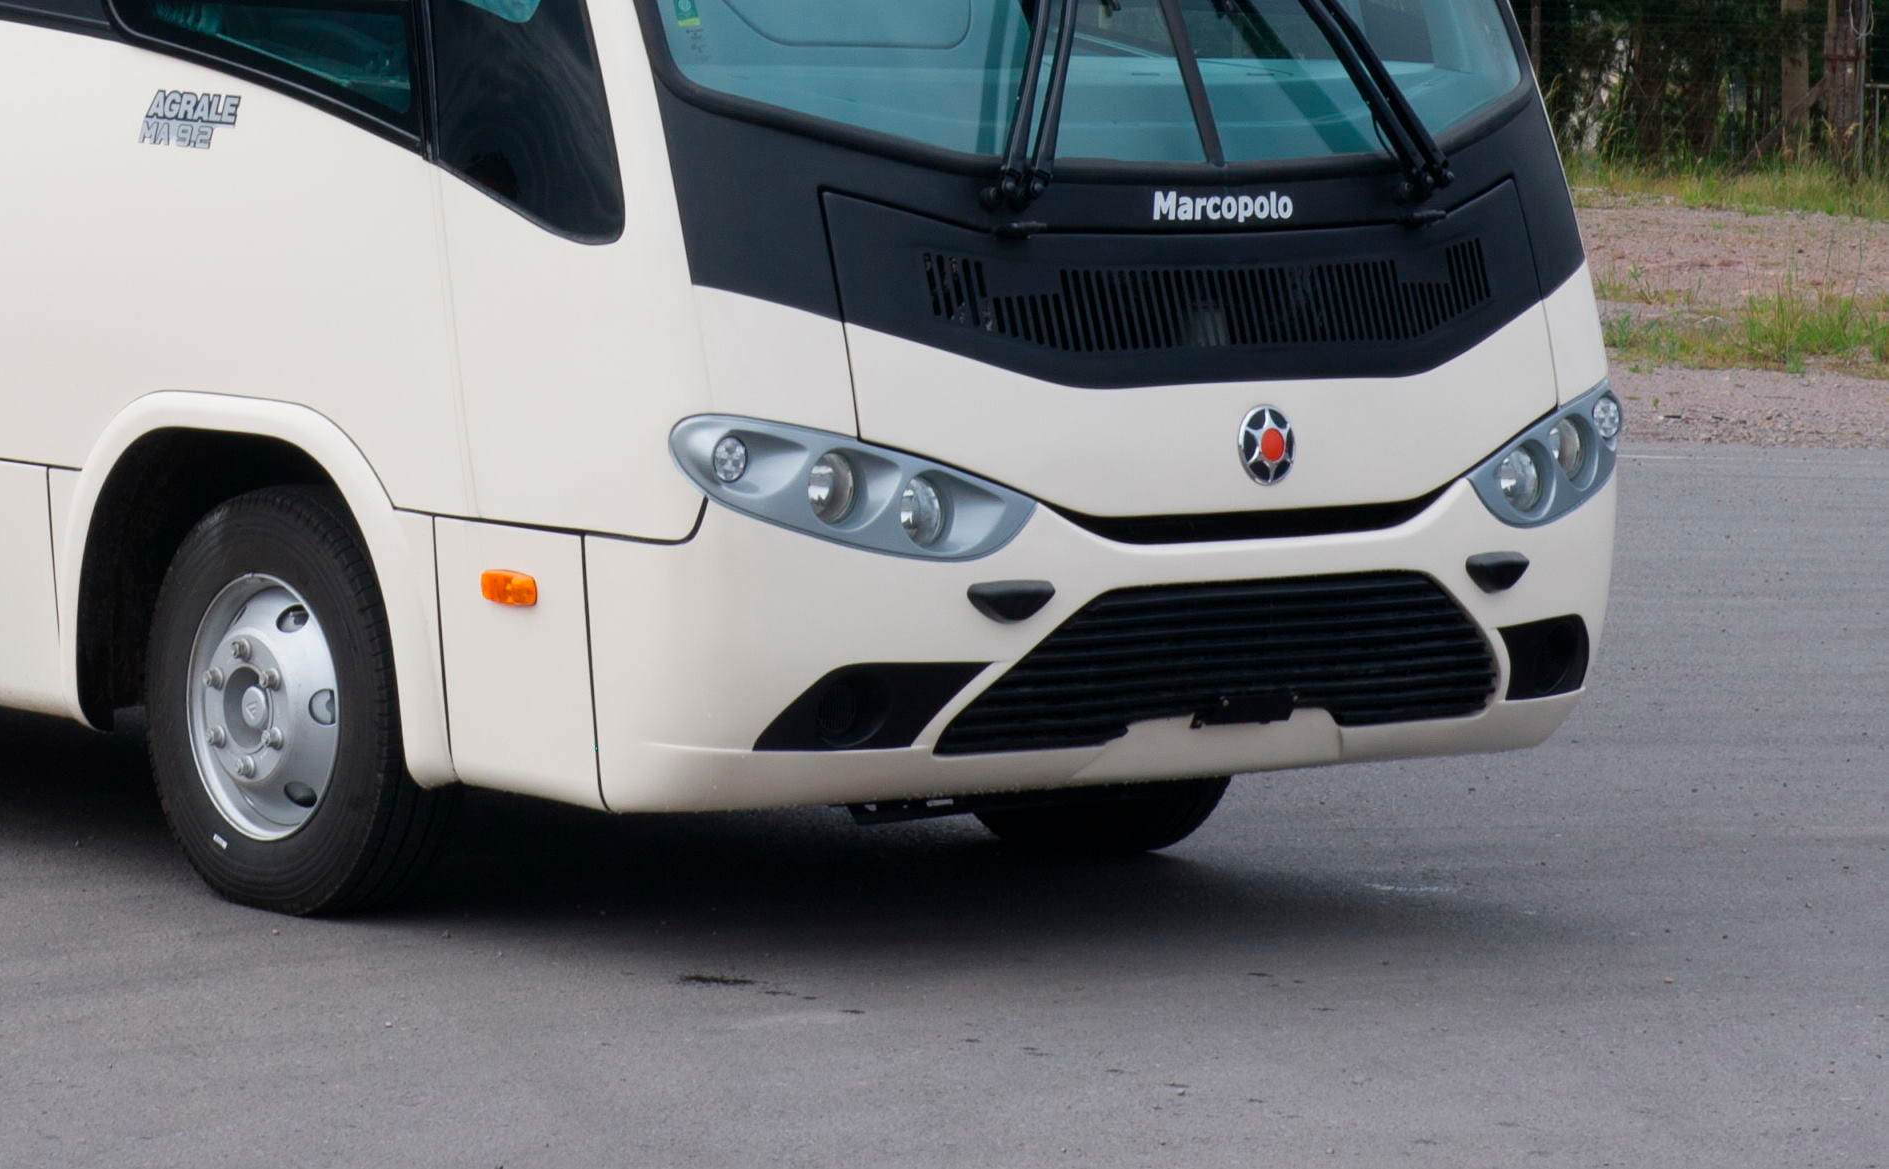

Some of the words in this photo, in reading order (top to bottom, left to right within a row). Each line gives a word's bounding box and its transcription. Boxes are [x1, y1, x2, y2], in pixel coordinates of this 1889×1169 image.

[144, 89, 242, 126] AGRALE
[138, 119, 170, 146] MA
[176, 123, 214, 150] 9.2
[1152, 190, 1294, 223] Marcopolo
